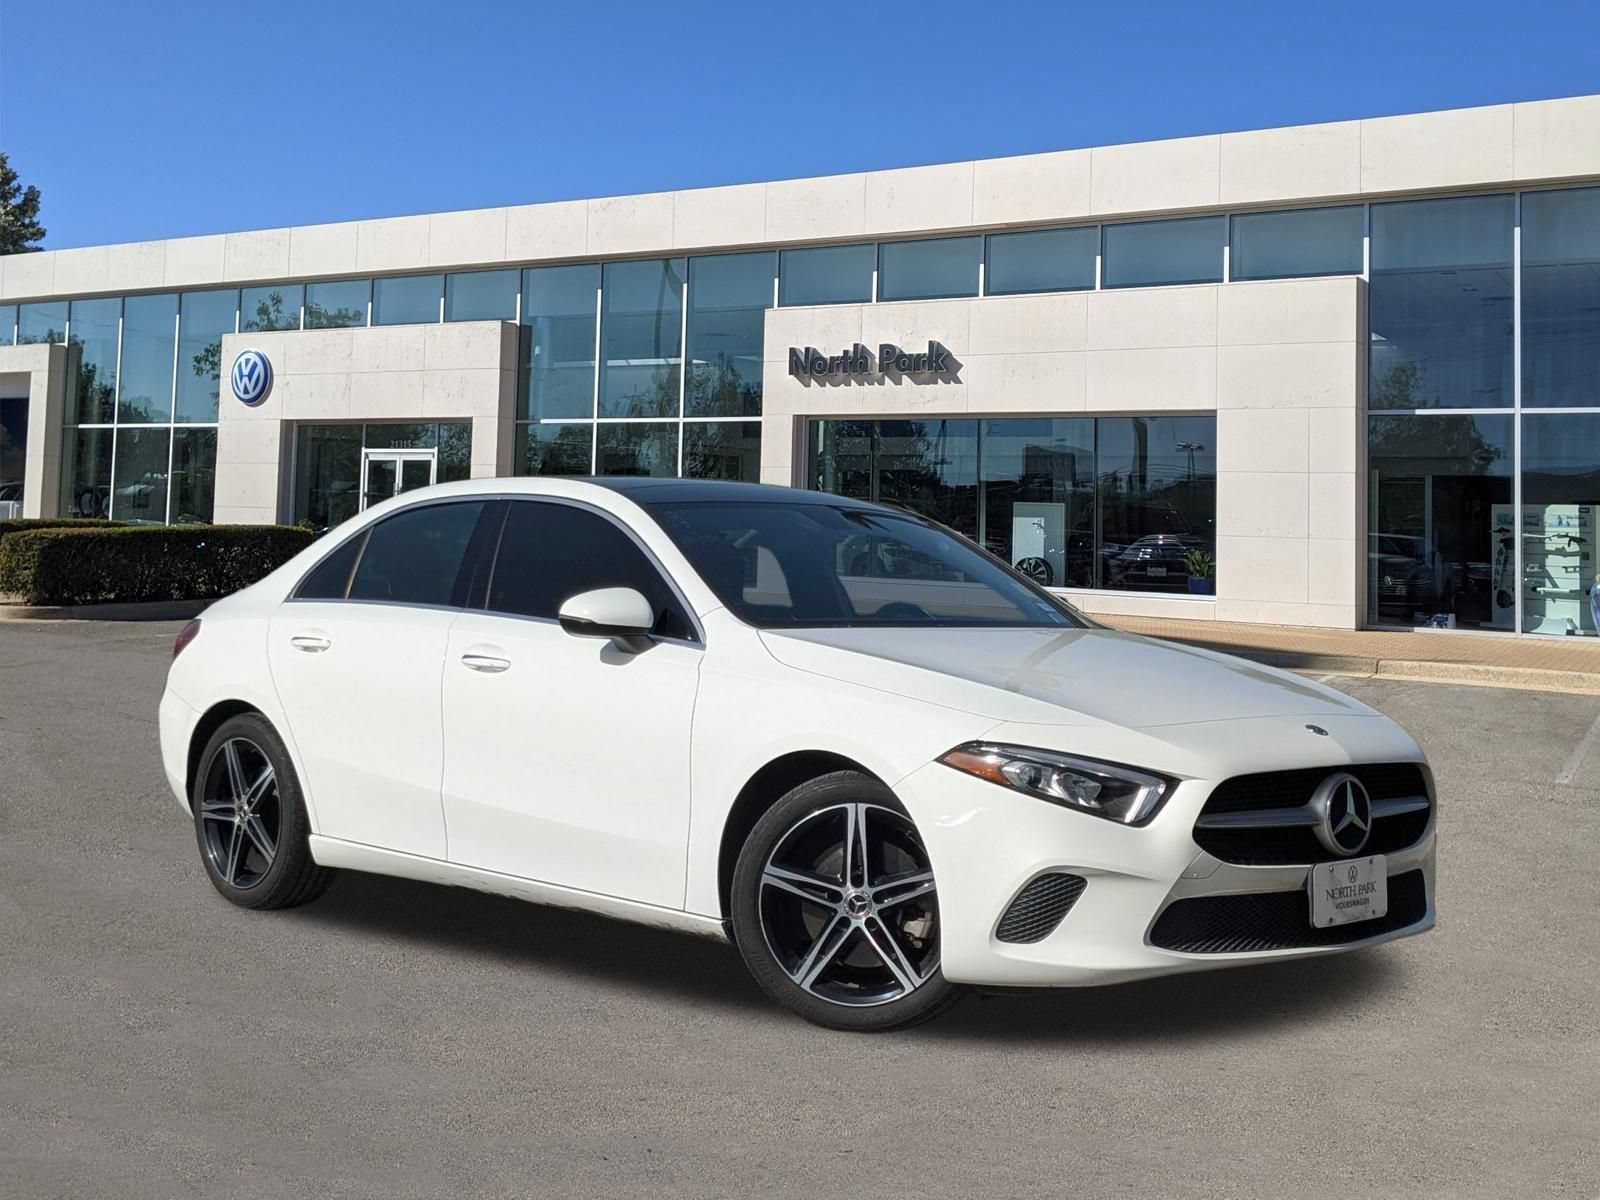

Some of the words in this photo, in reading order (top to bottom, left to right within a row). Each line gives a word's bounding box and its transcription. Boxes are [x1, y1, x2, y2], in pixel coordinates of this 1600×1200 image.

[788, 342, 872, 376] North
[878, 340, 948, 373] Park
[233, 353, 265, 400] VW
[1326, 884, 1357, 901] NORTH
[1358, 880, 1377, 896] PARK
[1335, 896, 1370, 910] VOLKSWAGEN
